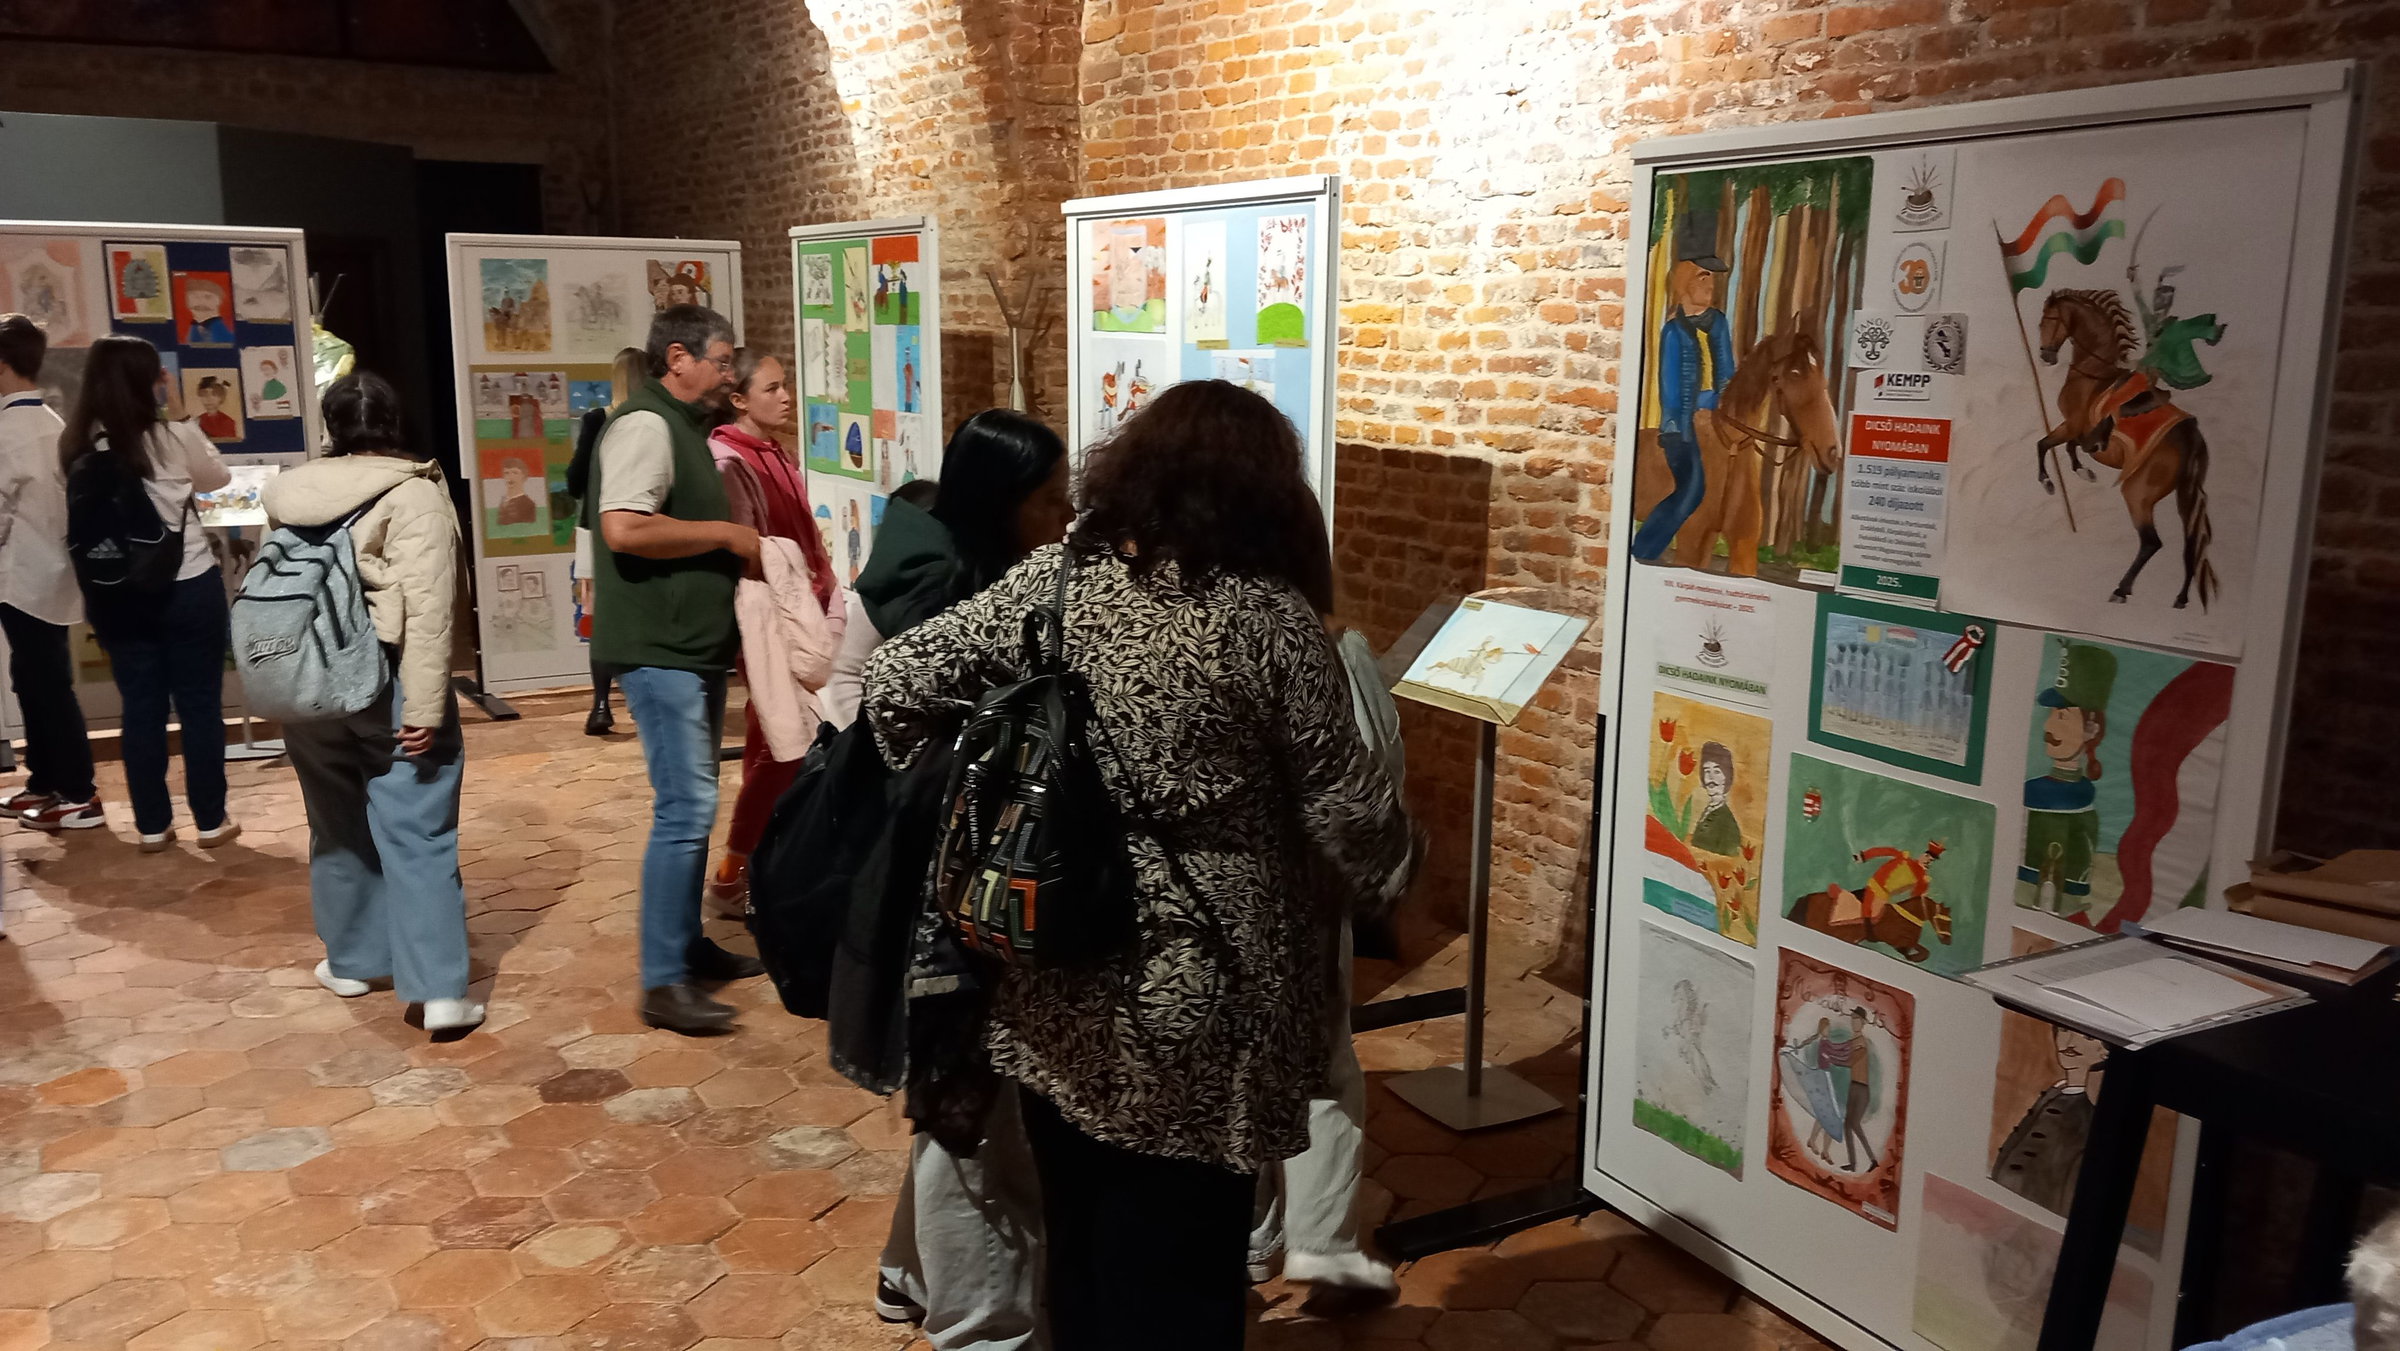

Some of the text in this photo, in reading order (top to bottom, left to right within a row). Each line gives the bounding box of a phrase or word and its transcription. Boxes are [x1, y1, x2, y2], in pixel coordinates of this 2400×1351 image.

[1854, 317, 1895, 337] TANODA
[1886, 373, 1932, 388] KEMPP
[1865, 419, 1941, 435] DICSŐ HADAINK
[1871, 440, 1930, 454] NYOMÁBAN
[1883, 466, 1942, 480] pályamunka
[1887, 498, 1924, 511] díjazott
[1658, 665, 1767, 694] DICSŐ HADAINK NYOMÁBAN
